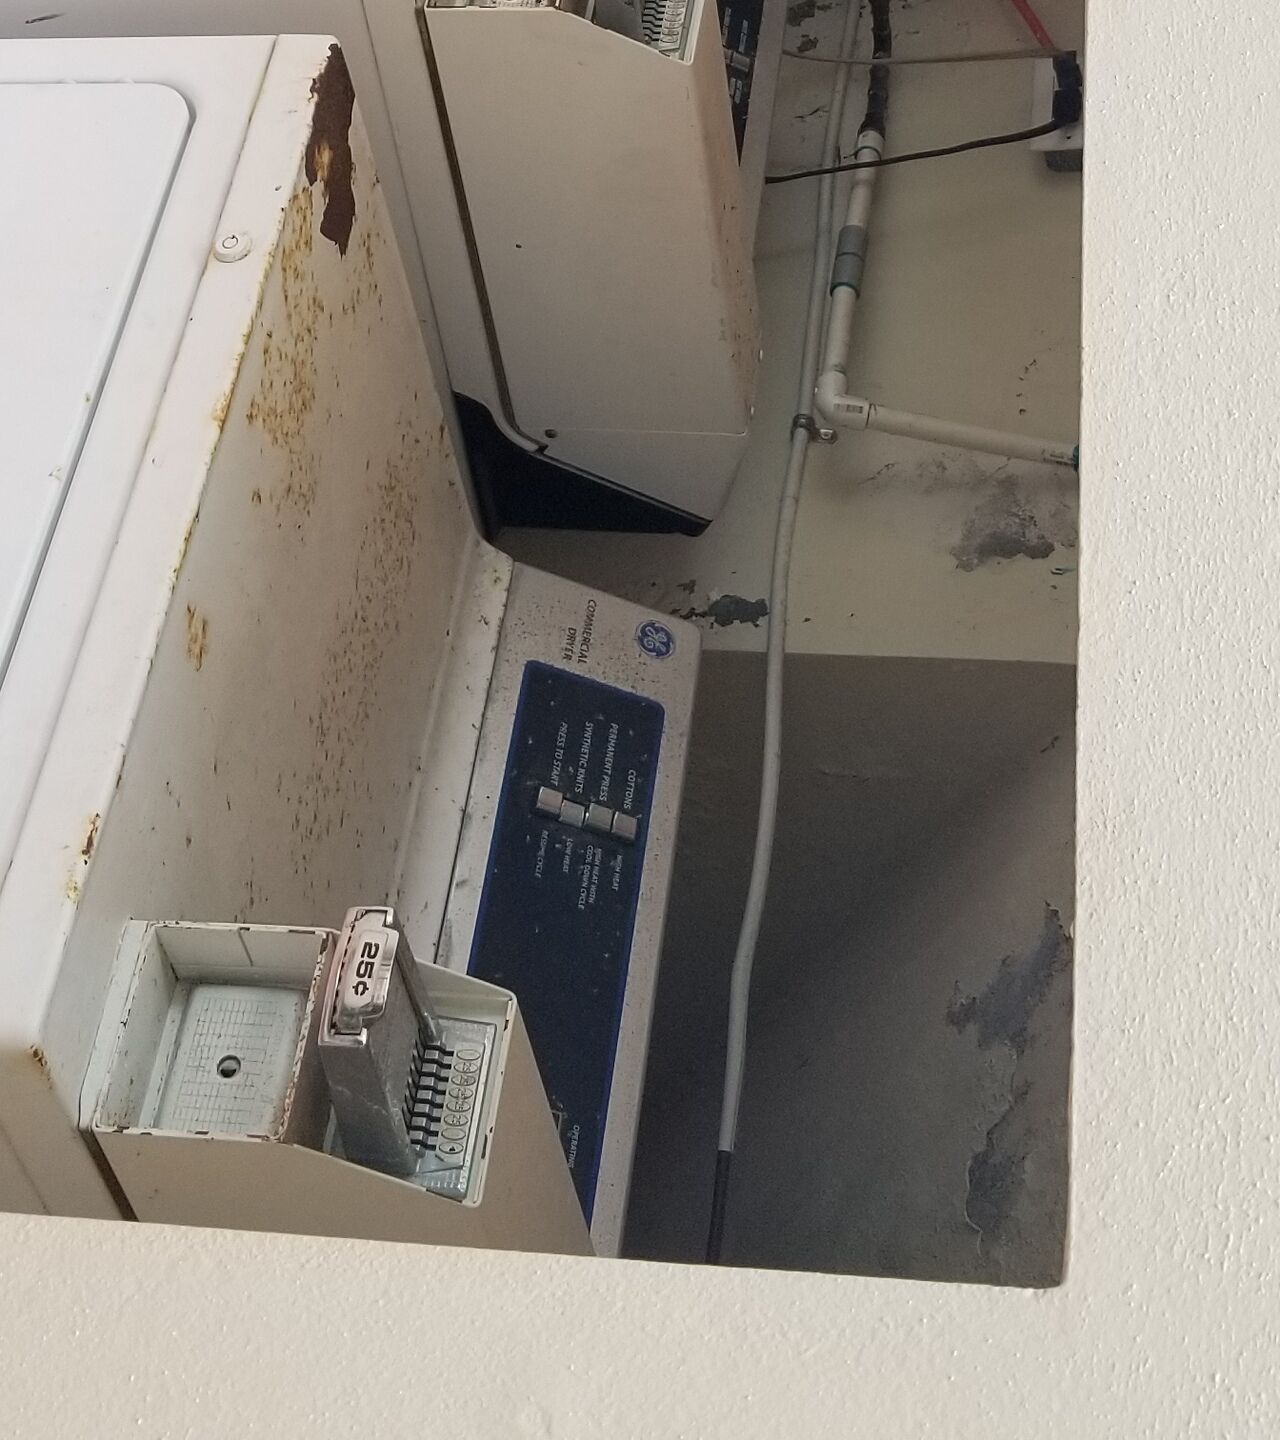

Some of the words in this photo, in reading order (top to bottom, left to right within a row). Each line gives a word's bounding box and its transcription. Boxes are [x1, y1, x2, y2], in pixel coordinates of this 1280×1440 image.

[577, 599, 597, 664] COMMERCIAL
[562, 627, 577, 661] DRYER
[556, 722, 568, 746] PRESS
[578, 721, 594, 768] SYNTHETIC
[554, 748, 564, 760] TO
[604, 723, 618, 774] PERMANENT
[550, 760, 562, 786] START
[574, 768, 585, 794] KNITS
[599, 775, 610, 801] PRESS
[623, 770, 636, 810] COTTONS
[564, 838, 573, 855] LOW
[585, 845, 594, 864] COOL
[535, 857, 544, 878] CYCLE
[562, 856, 570, 874] HEAT
[582, 864, 590, 888] DOWN
[591, 866, 599, 884] HEAT
[611, 872, 620, 892] HEAT
[578, 888, 587, 910] CYCLE
[588, 885, 596, 904] WITH
[352, 942, 380, 996] 25¢
